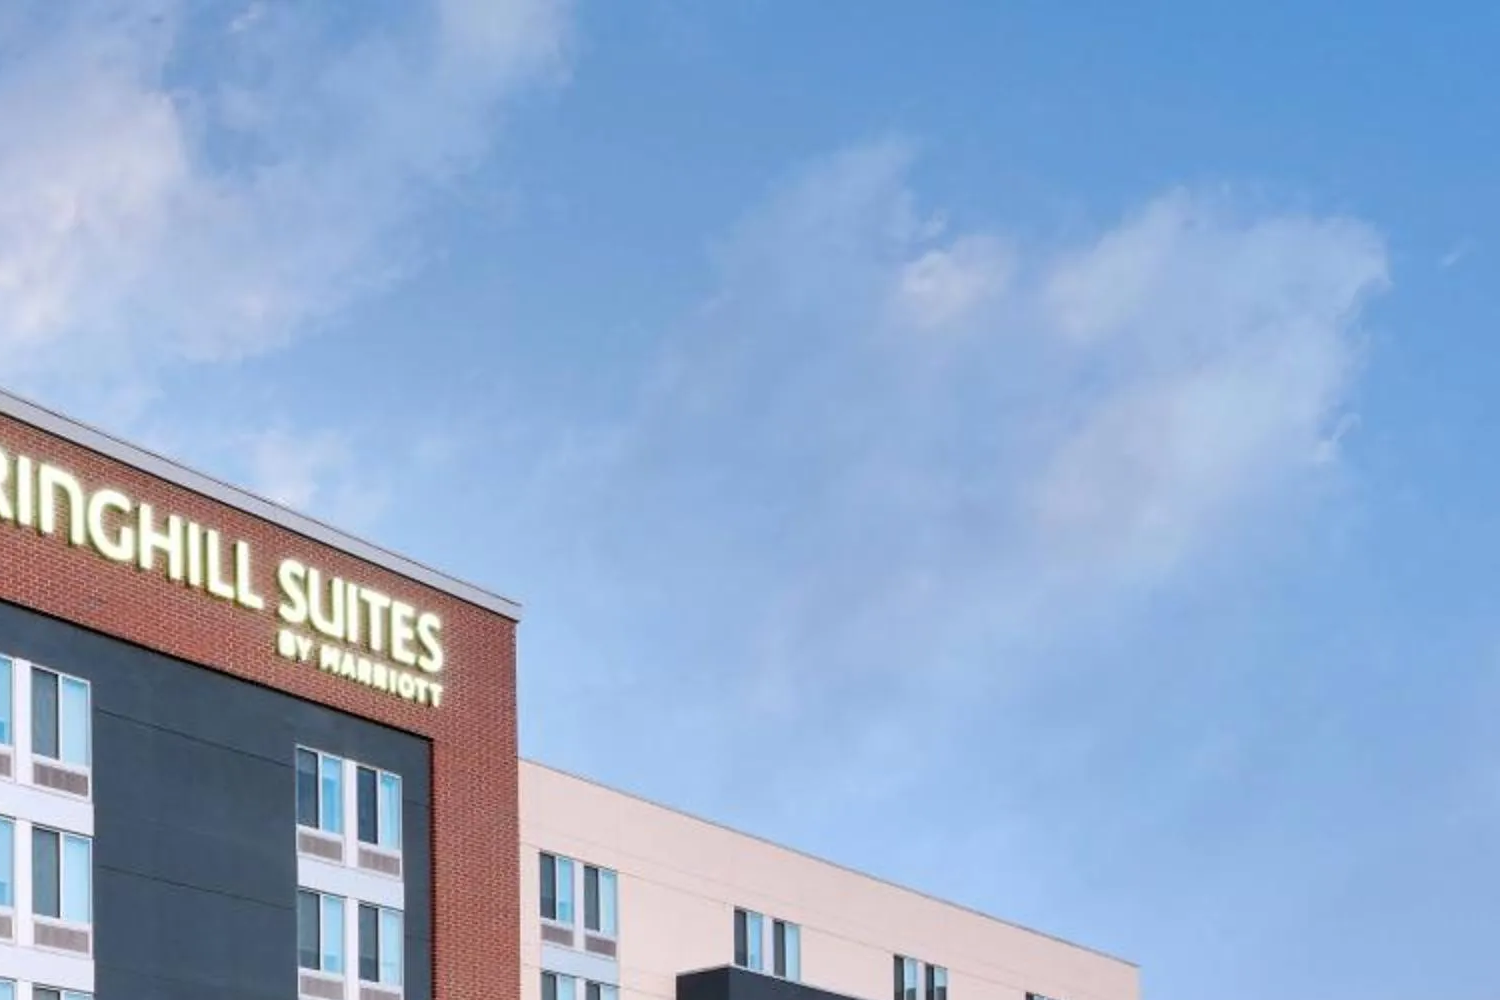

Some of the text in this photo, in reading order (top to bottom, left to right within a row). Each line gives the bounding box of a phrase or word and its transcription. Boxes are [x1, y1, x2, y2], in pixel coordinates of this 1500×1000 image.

[278, 558, 443, 673] SUITES
[278, 629, 443, 708] BY MARRIOTT
